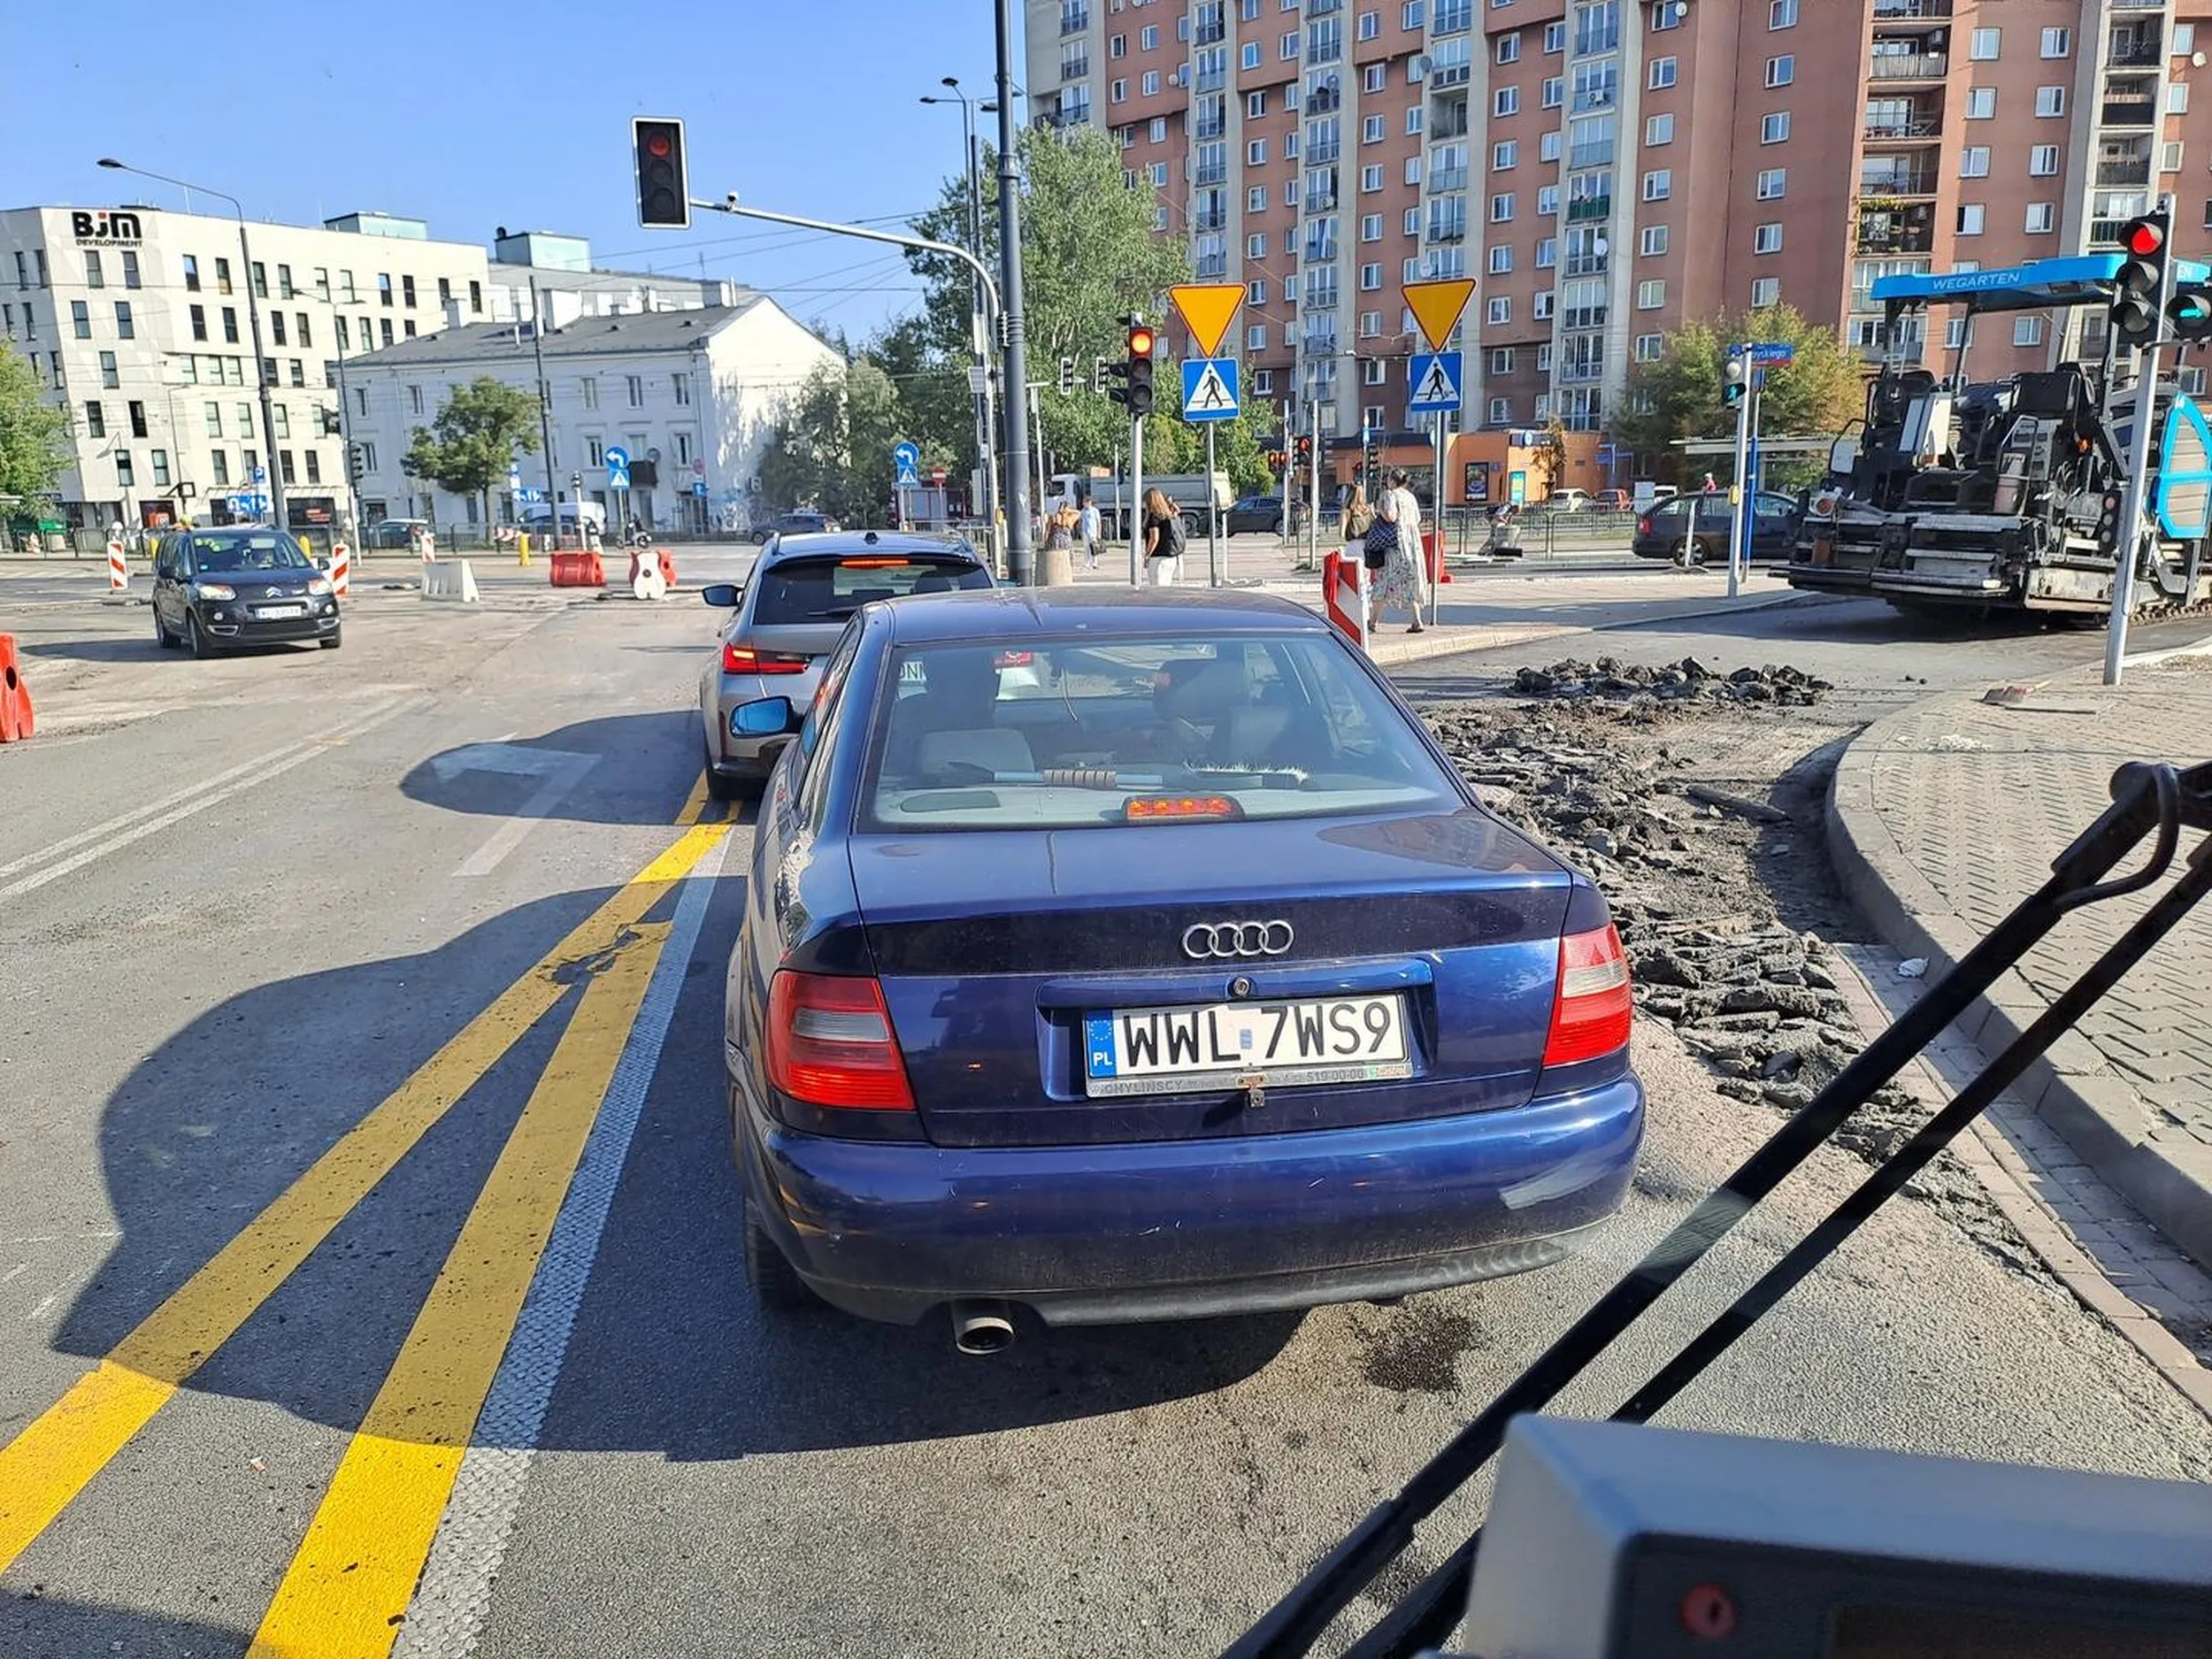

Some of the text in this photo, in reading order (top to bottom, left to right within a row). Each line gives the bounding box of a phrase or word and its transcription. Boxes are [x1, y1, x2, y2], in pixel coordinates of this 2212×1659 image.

[76, 239, 142, 248] DEVELOPMENT
[1932, 272, 2020, 290] WEGARTEN
[1123, 1002, 1391, 1067] WWL 7WS9
[1093, 1052, 1113, 1067] PL
